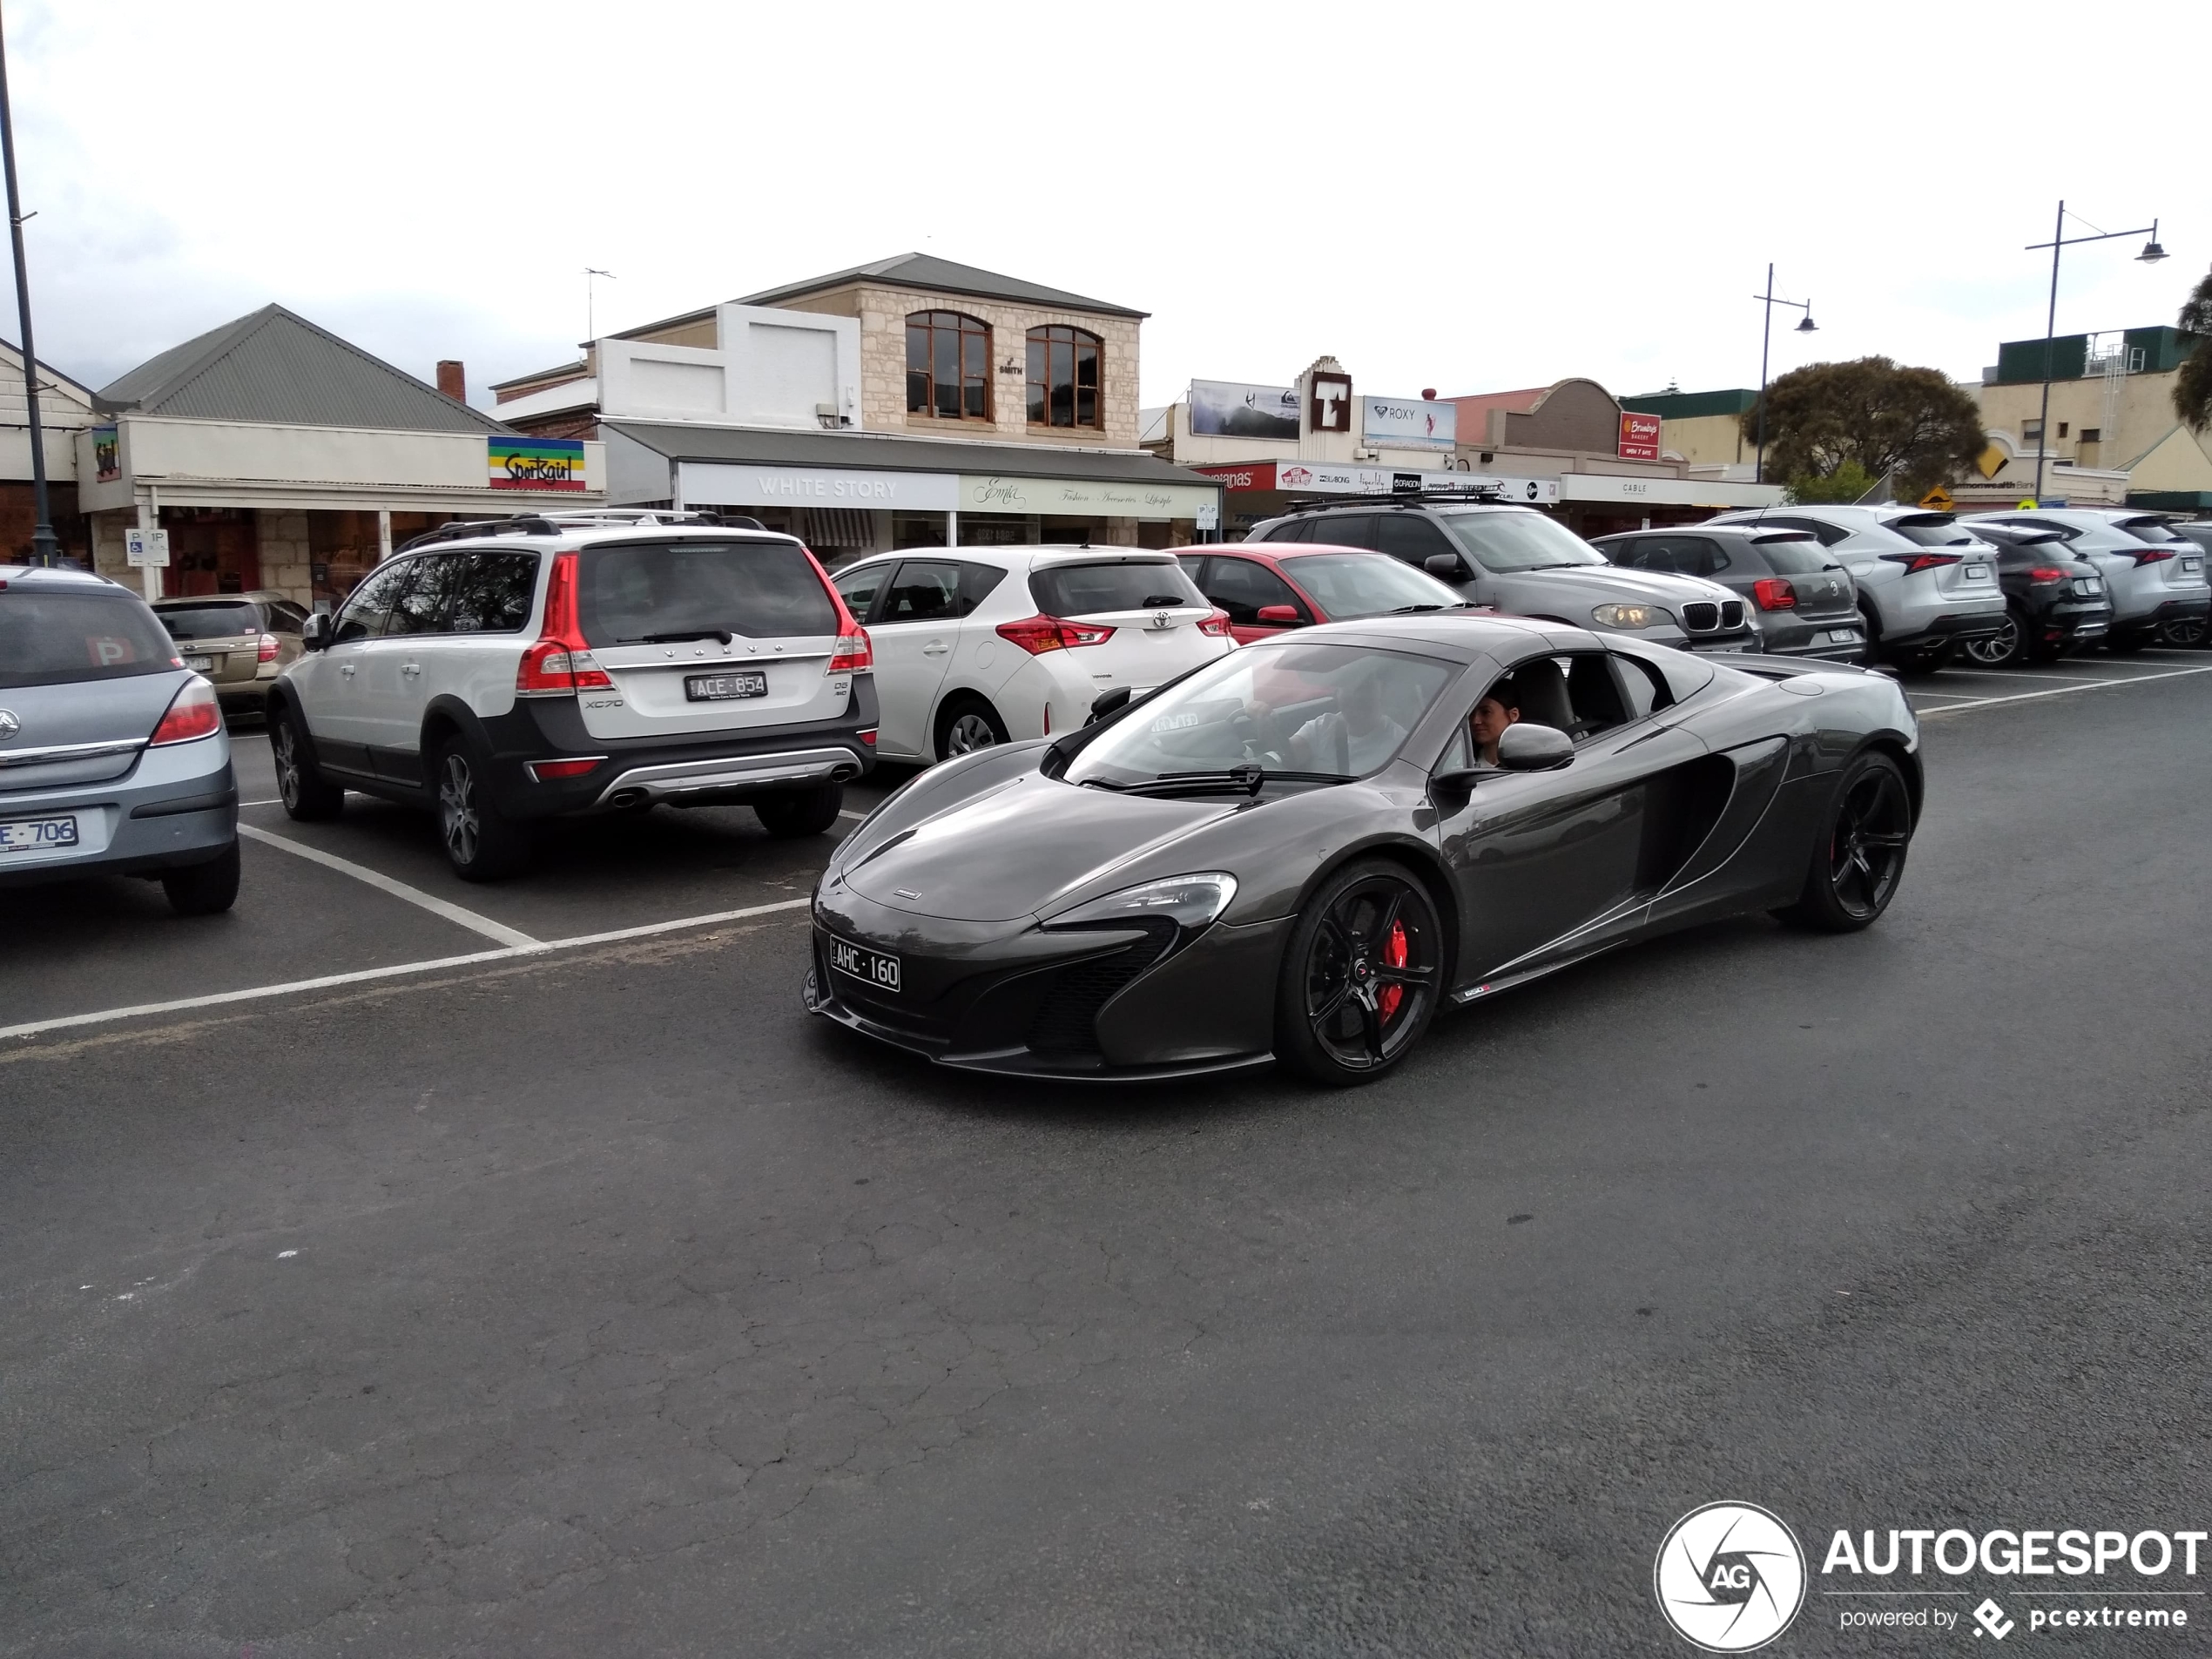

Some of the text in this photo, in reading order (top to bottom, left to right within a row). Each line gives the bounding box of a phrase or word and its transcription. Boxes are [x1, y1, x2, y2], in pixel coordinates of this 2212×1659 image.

[1000, 366, 1022, 374] SMITH
[1390, 408, 1416, 421] ROXY
[504, 453, 571, 485] Sportsgirl
[758, 477, 897, 499] WHITE STORY
[1399, 479, 1421, 488] DRAGON
[1623, 484, 1647, 493] CABLE
[2016, 481, 2036, 489] Bank
[1059, 489, 1089, 502] Fashion
[132, 532, 165, 542] P 1P
[96, 642, 124, 666] P
[664, 644, 784, 658] VOLVO
[585, 699, 624, 710] XC70
